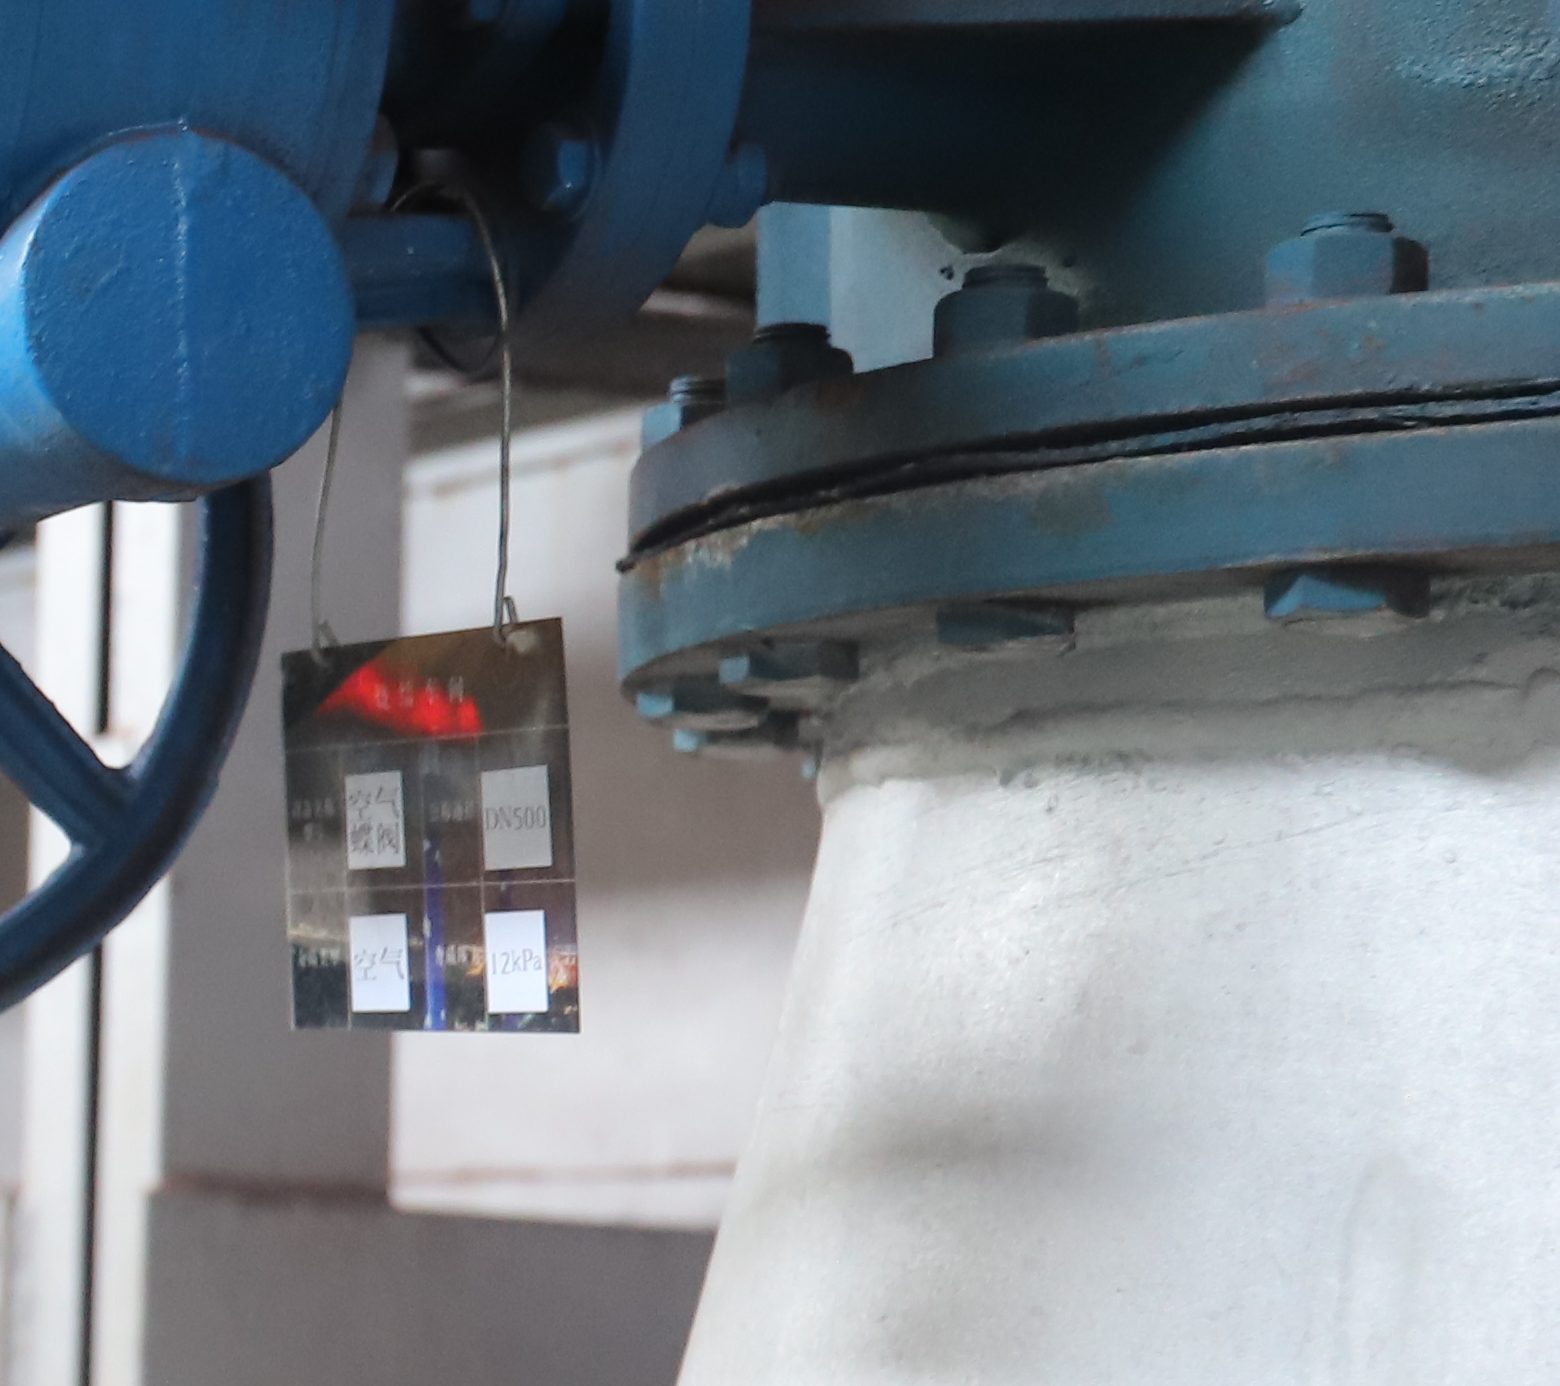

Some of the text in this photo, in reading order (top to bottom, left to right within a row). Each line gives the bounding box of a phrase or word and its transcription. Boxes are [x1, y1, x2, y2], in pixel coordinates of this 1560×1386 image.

[348, 785, 400, 820] 空气
[485, 805, 547, 831] DN500
[349, 821, 400, 856] 蝶阀
[353, 945, 405, 982] 空气
[490, 947, 543, 976] 12kPa
